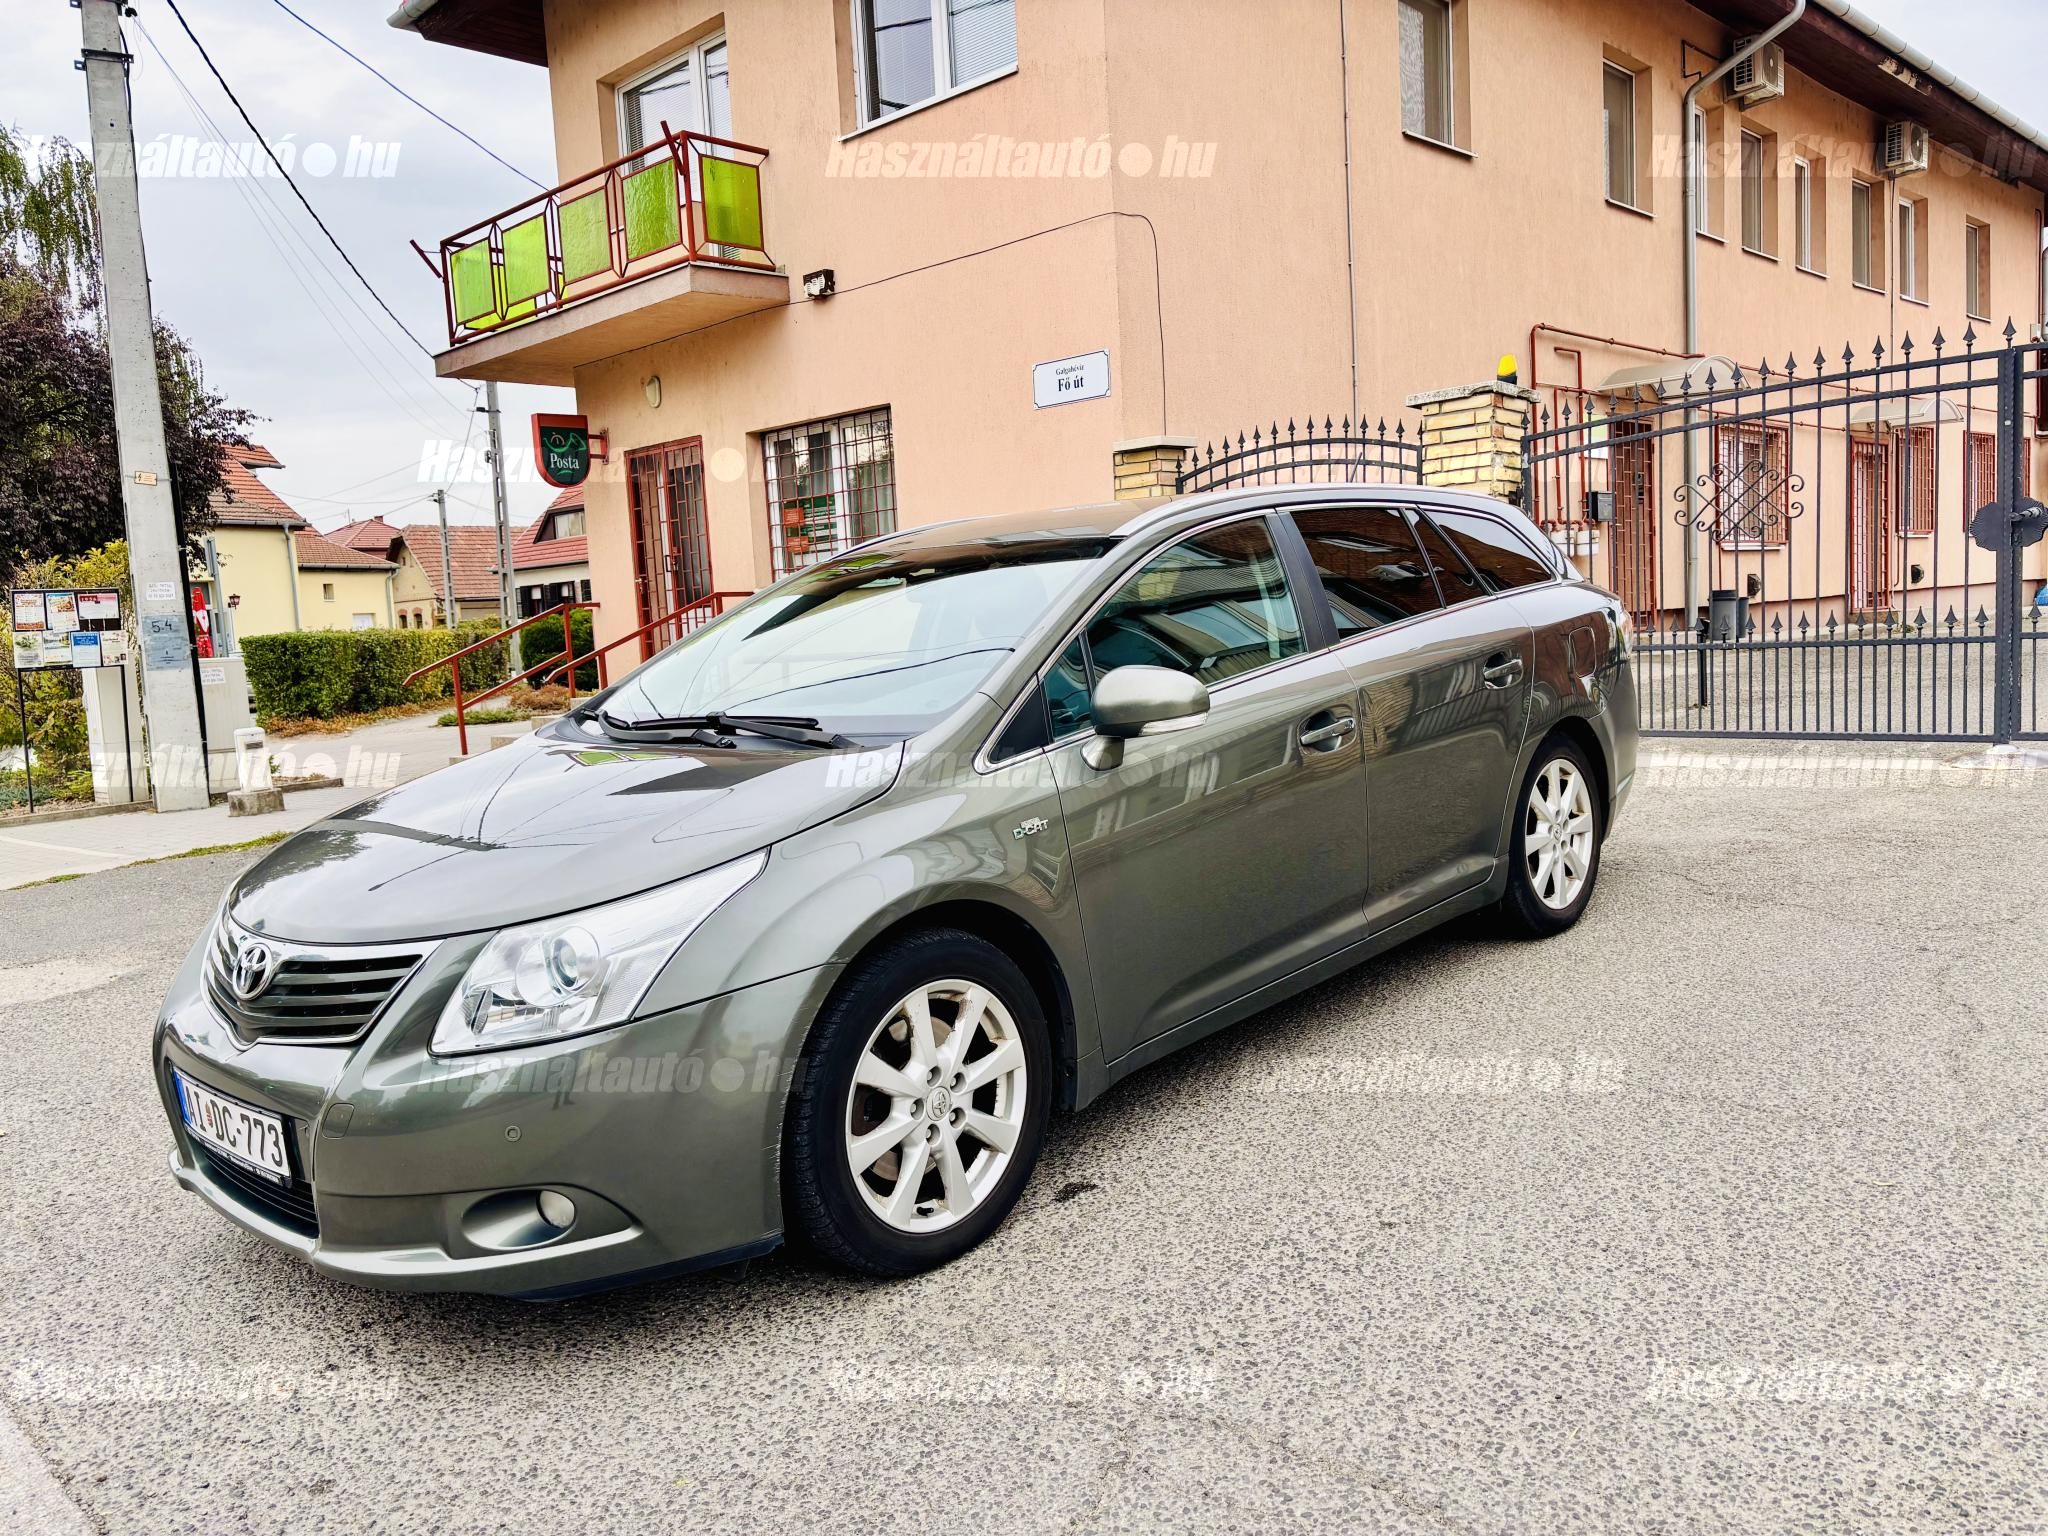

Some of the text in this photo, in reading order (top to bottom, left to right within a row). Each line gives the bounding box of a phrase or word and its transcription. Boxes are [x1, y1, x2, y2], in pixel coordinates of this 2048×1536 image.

[1058, 375, 1084, 392] Fő út
[550, 453, 580, 469] Posta
[185, 1086, 207, 1132] AI
[209, 1099, 283, 1168] DC-773
